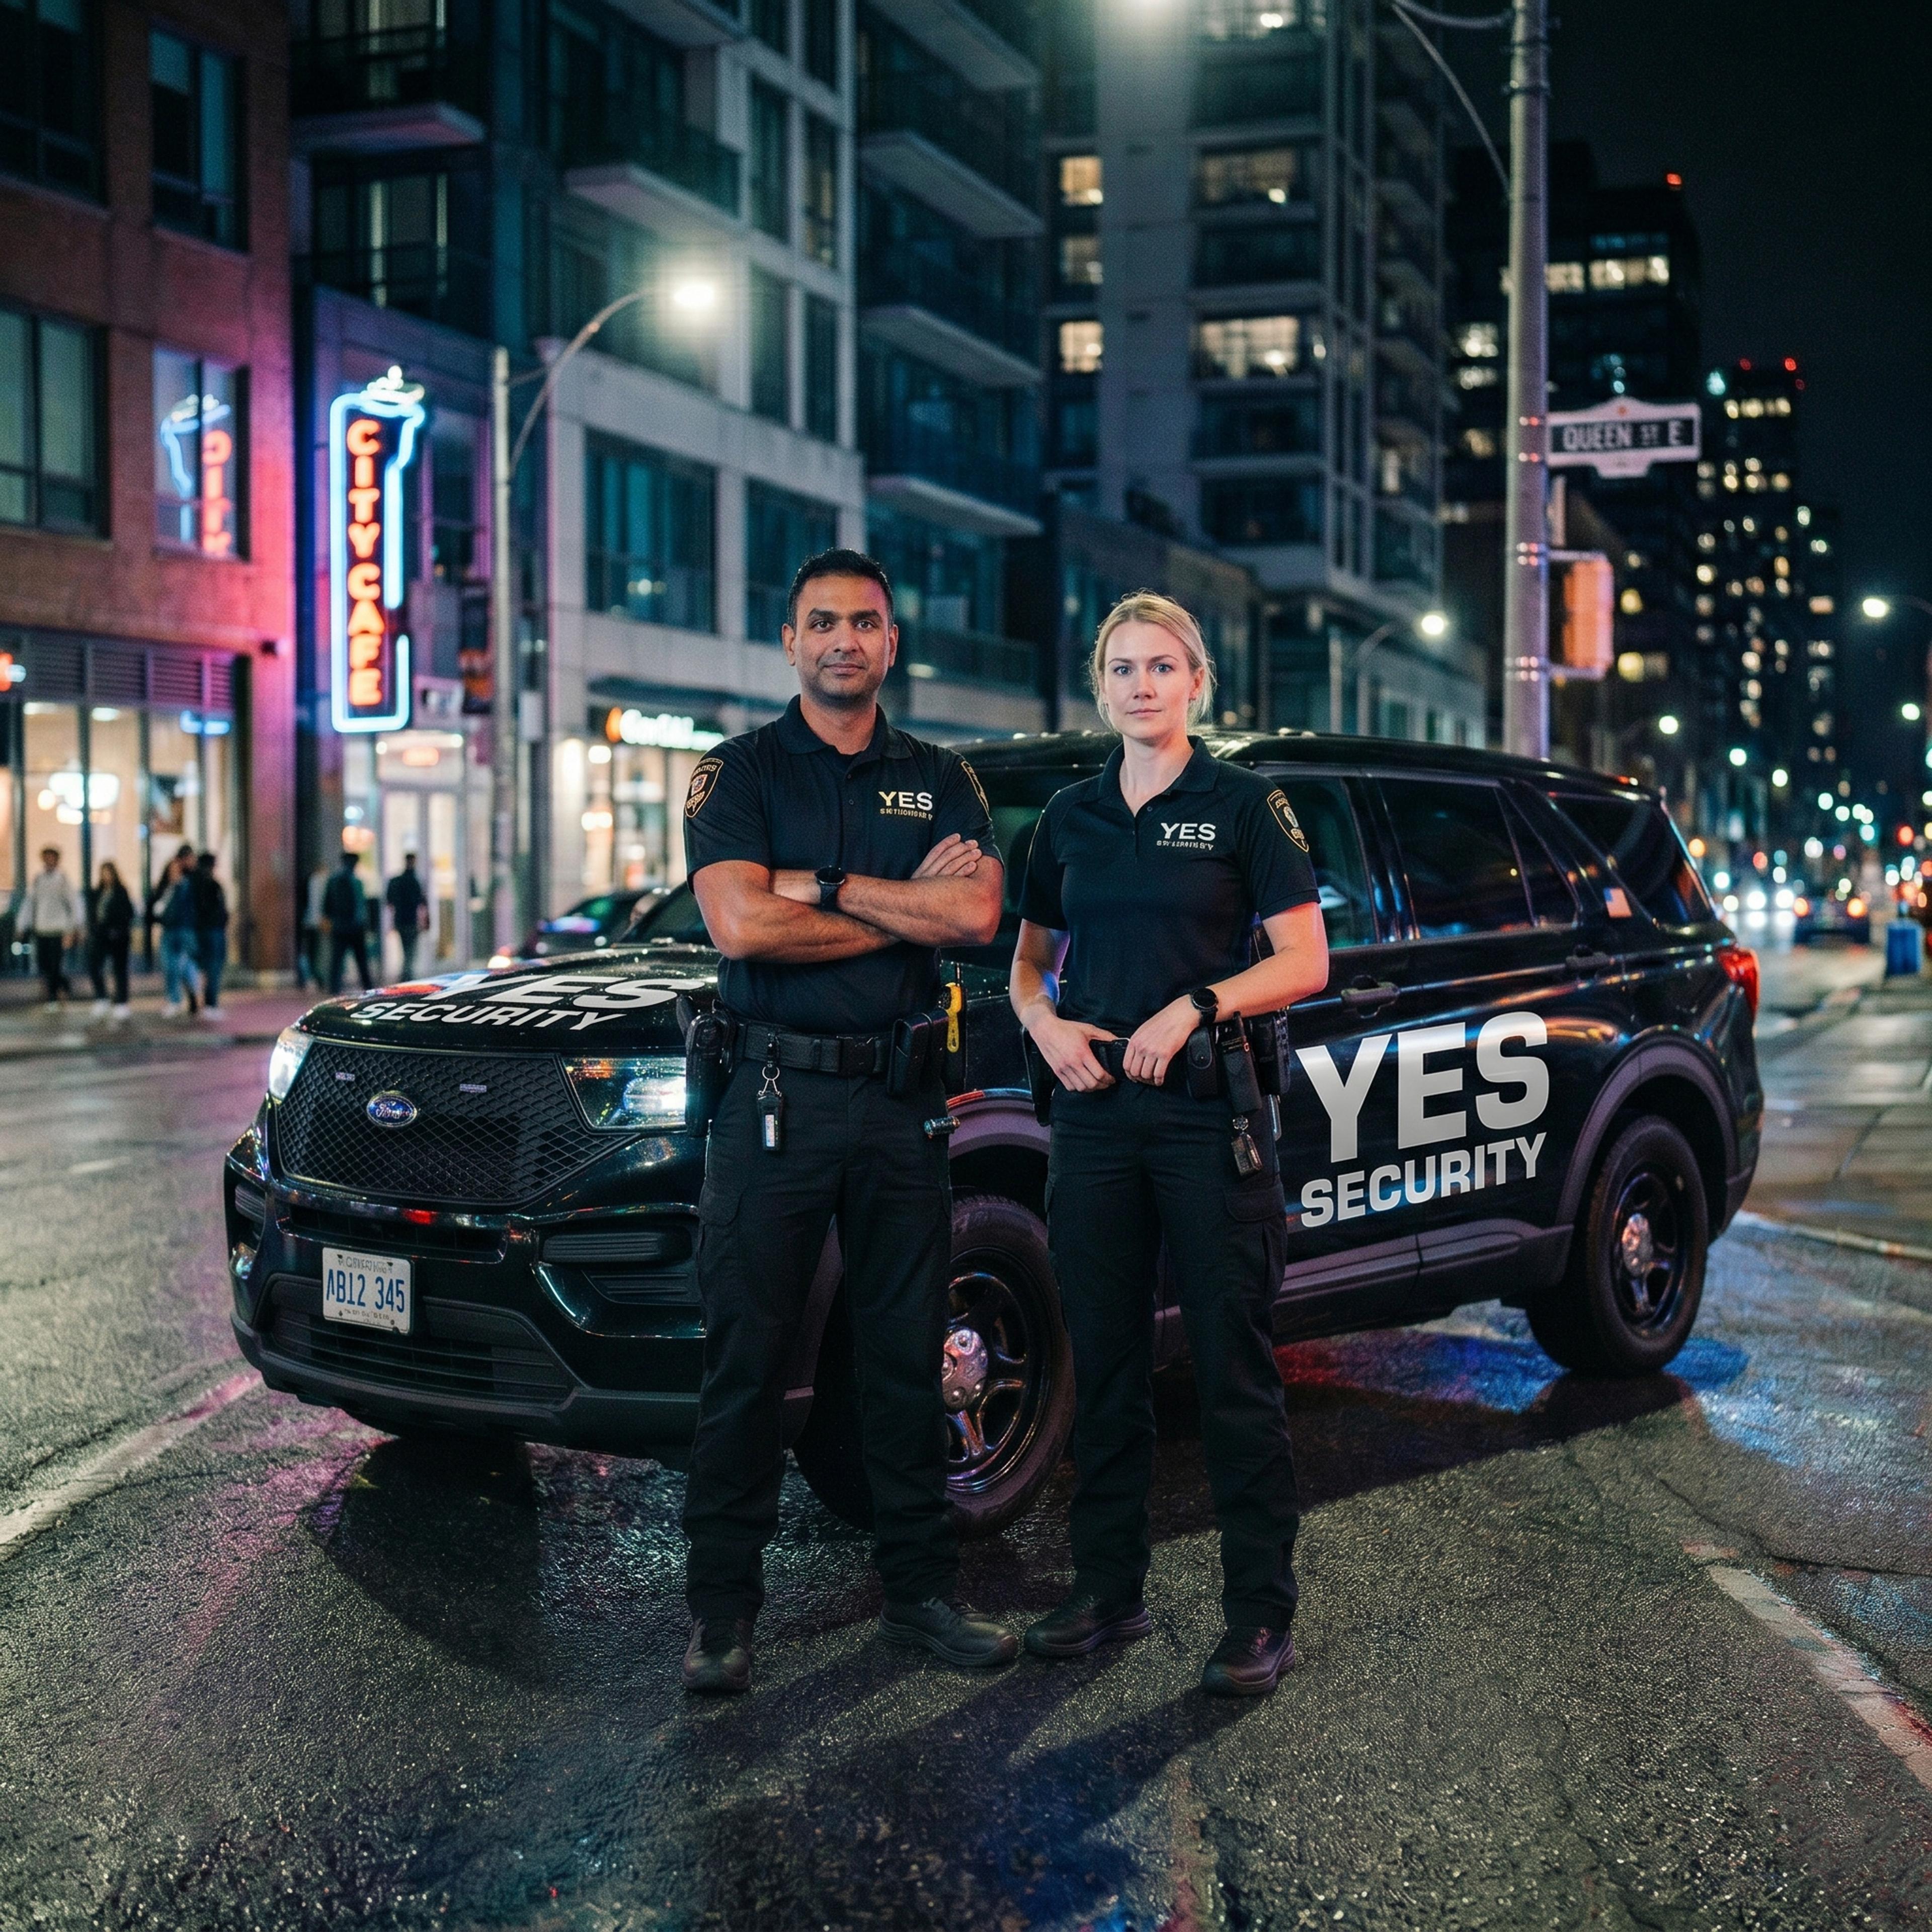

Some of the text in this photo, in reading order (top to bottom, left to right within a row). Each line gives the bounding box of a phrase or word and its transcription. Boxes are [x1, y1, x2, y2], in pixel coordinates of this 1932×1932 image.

[1562, 422, 1632, 451] QUEEN
[1667, 420, 1683, 446] E
[878, 791, 933, 811] YES
[1160, 822, 1217, 841] YES
[420, 974, 706, 1009] YES
[350, 1002, 627, 1031] SECURITY
[1295, 1011, 1550, 1163] YES
[1301, 1132, 1547, 1228] SECURITY
[326, 1268, 405, 1313] AB12 345
